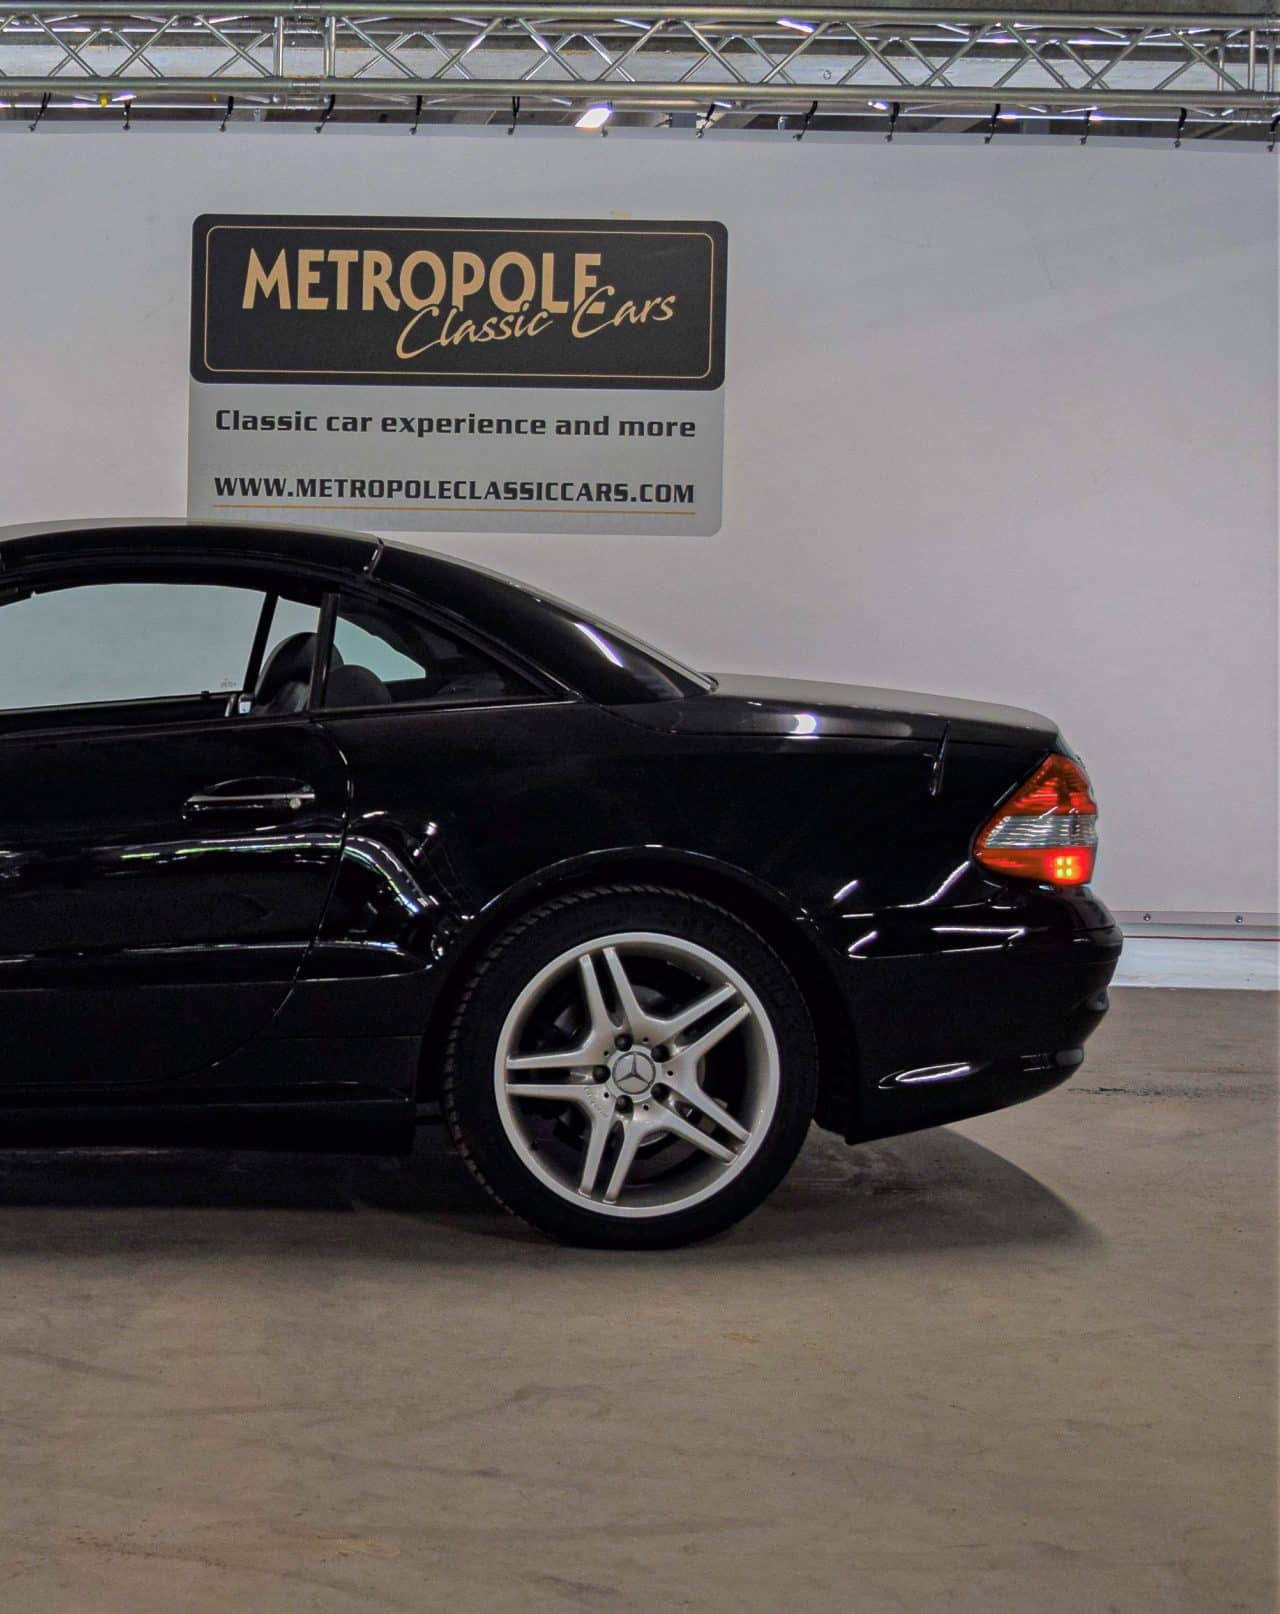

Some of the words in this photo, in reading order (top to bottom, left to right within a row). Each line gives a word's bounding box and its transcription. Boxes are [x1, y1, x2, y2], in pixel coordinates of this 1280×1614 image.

[242, 247, 606, 315] METROPOLE
[395, 301, 554, 359] Classic
[571, 285, 677, 339] Cars
[215, 409, 318, 433] Classic
[326, 415, 373, 433] car
[380, 412, 547, 438] experience
[555, 415, 610, 436] and
[618, 418, 696, 438] more
[213, 476, 695, 504] WWW.METROPOLECLASSICCARS.COM
